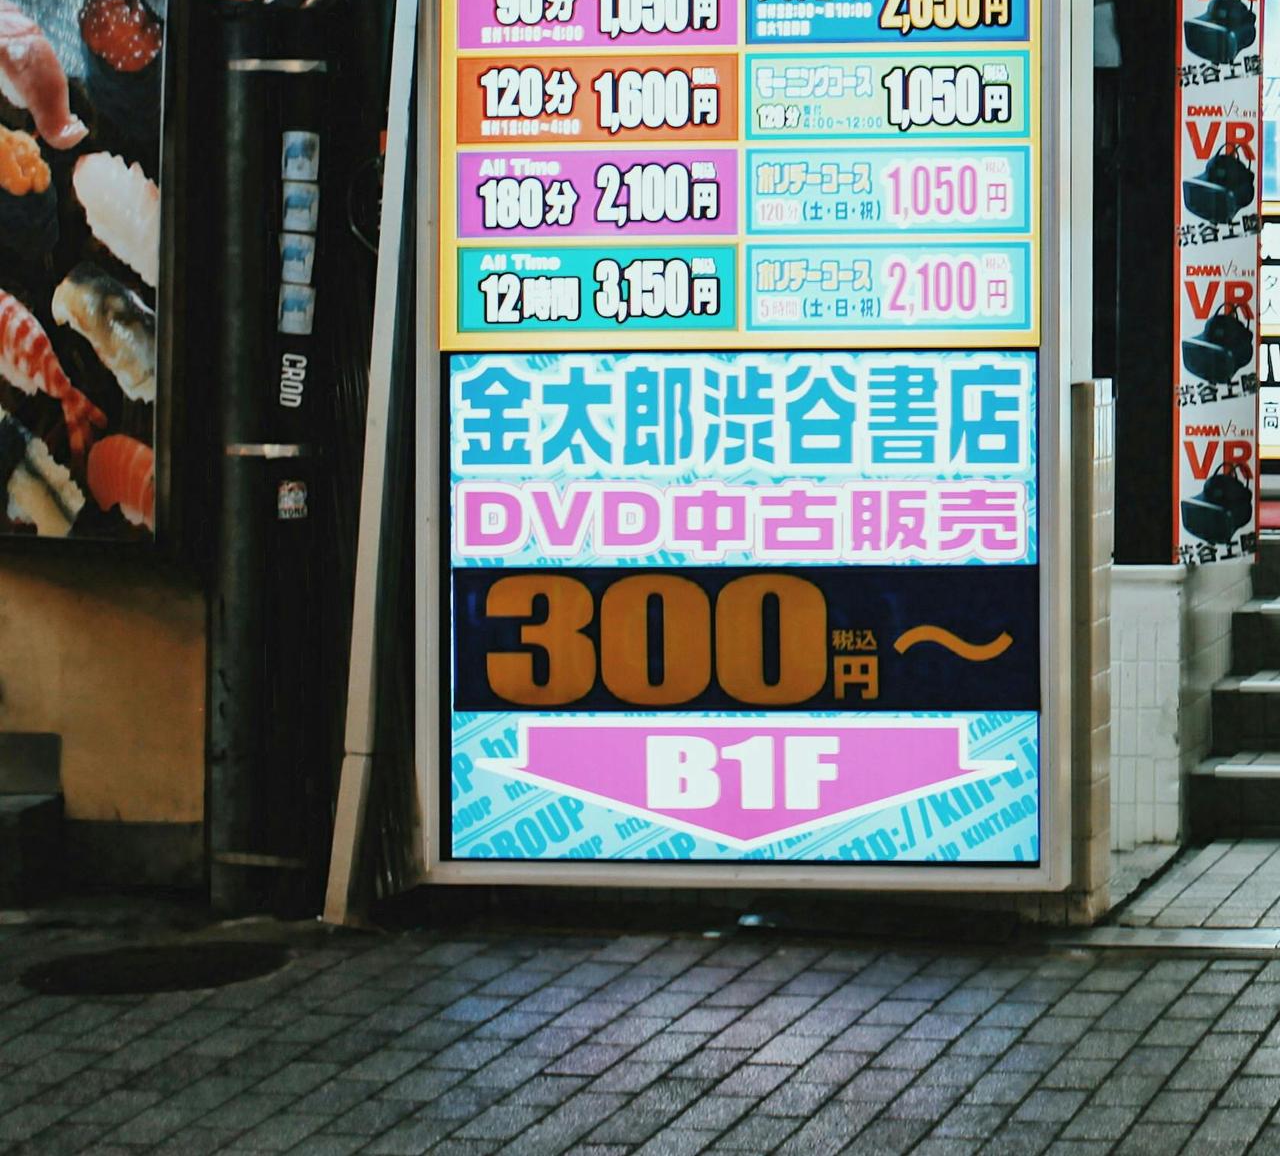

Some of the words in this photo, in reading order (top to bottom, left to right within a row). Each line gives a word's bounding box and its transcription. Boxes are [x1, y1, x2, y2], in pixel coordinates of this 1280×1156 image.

[479, 67, 579, 118] 120分
[592, 70, 718, 134] 1,600円
[756, 65, 873, 98] モーニングコース
[882, 65, 1012, 131] 1,050円
[803, 116, 883, 128] 4:00~12:00
[1186, 121, 1256, 160] VR
[480, 159, 506, 176] All
[510, 159, 560, 176] Time
[756, 162, 872, 194] ホリデーコース
[887, 164, 1008, 220] 1,050円
[479, 177, 579, 228] 180分
[594, 163, 719, 227] 2,100円
[802, 201, 881, 221] (土・日・祝)
[480, 255, 507, 271] All
[511, 254, 561, 271] Time
[594, 258, 719, 323] 3,150円
[756, 259, 872, 292] ホリデーコース
[888, 260, 1008, 316] 2,100円
[802, 298, 881, 318] (土・日・祝)
[1185, 280, 1254, 320] VR
[460, 365, 1020, 467] 金太郎渋谷書店
[1184, 440, 1253, 480] VR
[464, 489, 1018, 552] DVD中古販売
[832, 628, 878, 651] 税込
[646, 734, 840, 810] B1F
